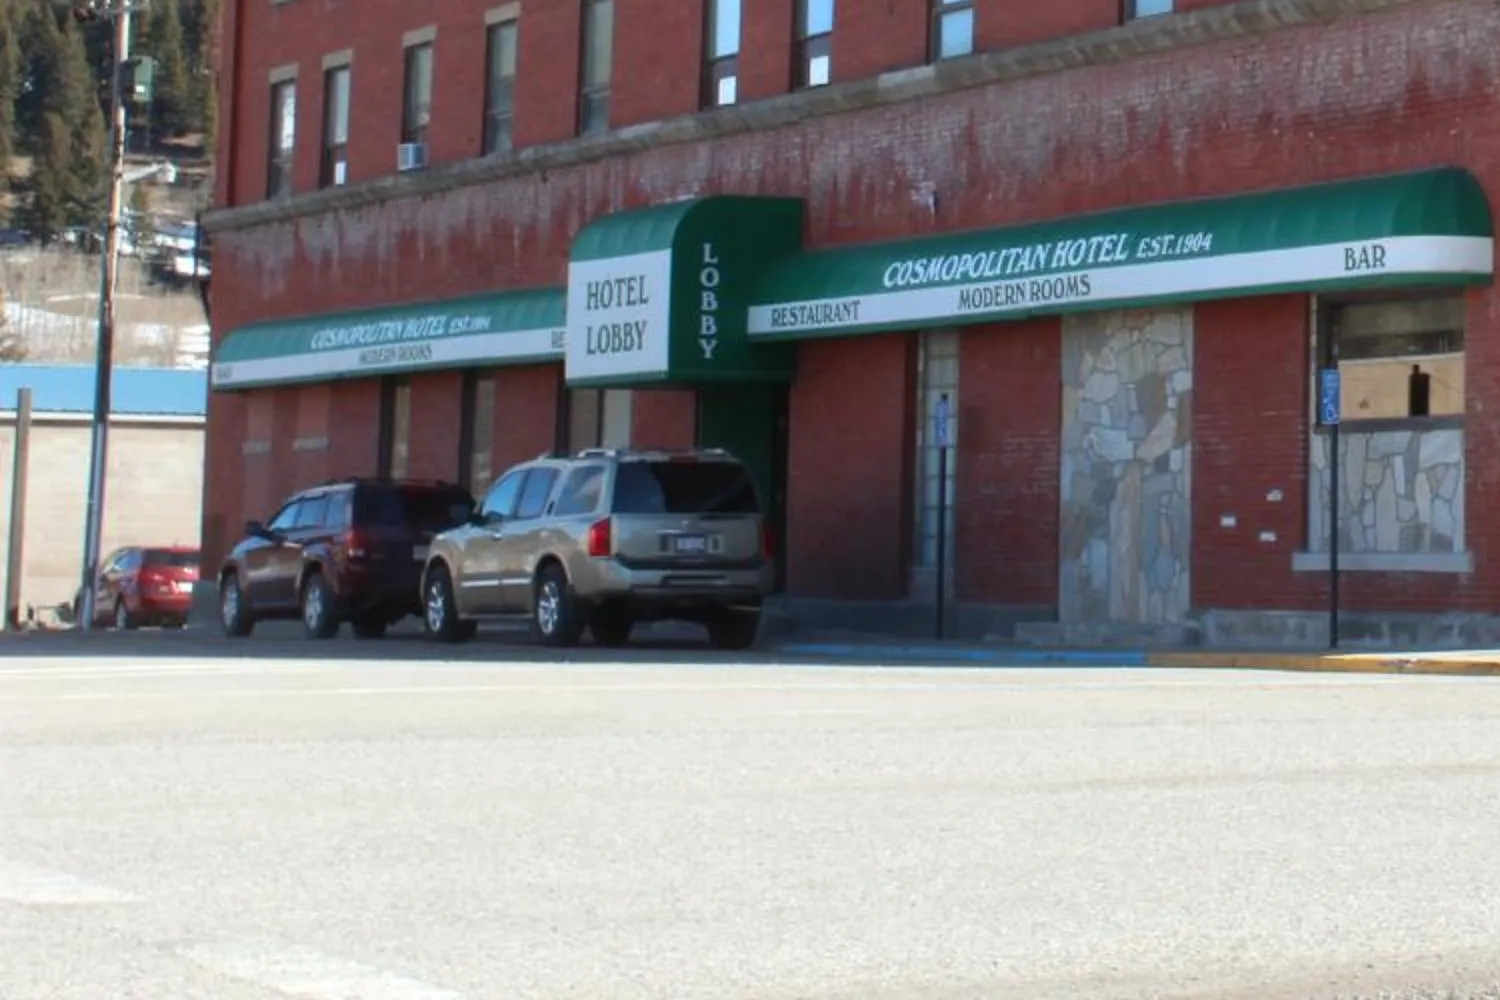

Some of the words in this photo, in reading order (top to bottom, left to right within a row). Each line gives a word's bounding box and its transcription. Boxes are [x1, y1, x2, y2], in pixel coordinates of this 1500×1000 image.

[883, 244, 1052, 288] COSMOPOLITAN
[1050, 233, 1129, 268] HOTEL
[1344, 245, 1386, 271] BAR
[586, 274, 649, 311] HOTEL
[700, 243, 719, 359] LOBBY
[957, 281, 1026, 310] MODERN
[1029, 274, 1091, 302] ROOMS
[770, 300, 861, 328] RESTAURANT
[586, 319, 648, 355] LOBBY
